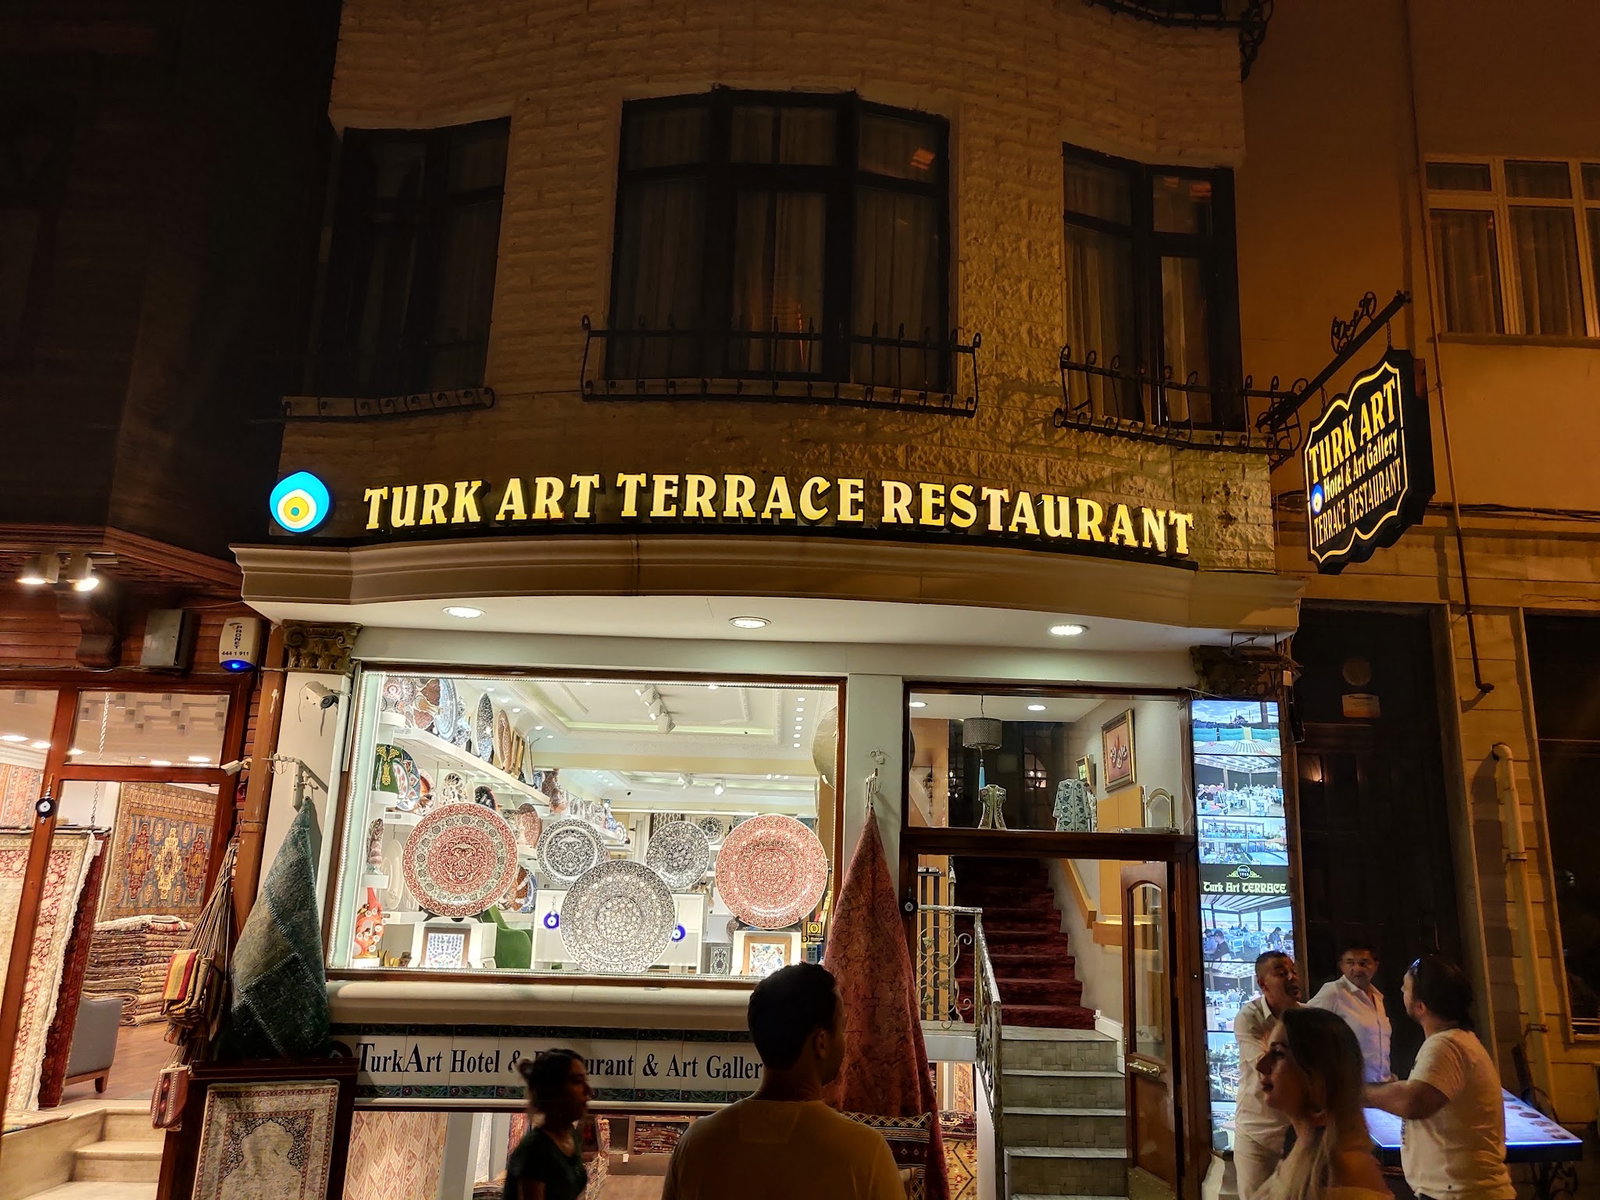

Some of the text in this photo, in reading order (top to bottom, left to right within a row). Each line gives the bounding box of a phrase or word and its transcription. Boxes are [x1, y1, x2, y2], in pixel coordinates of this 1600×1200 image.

[1309, 376, 1395, 484] TURK ART
[1323, 428, 1398, 503] Hotel & Art Gallery
[363, 472, 1195, 555] TURK ART TERRACE RESTAURANT
[1313, 457, 1401, 547] TERRACE RESTAURANT
[1203, 881, 1287, 894] Turk Art TERRACE
[355, 1042, 443, 1073] TurkArt
[449, 1049, 501, 1073] Hotel
[642, 1053, 659, 1077] &
[665, 1054, 699, 1078] Art
[706, 1055, 763, 1079] Galler
